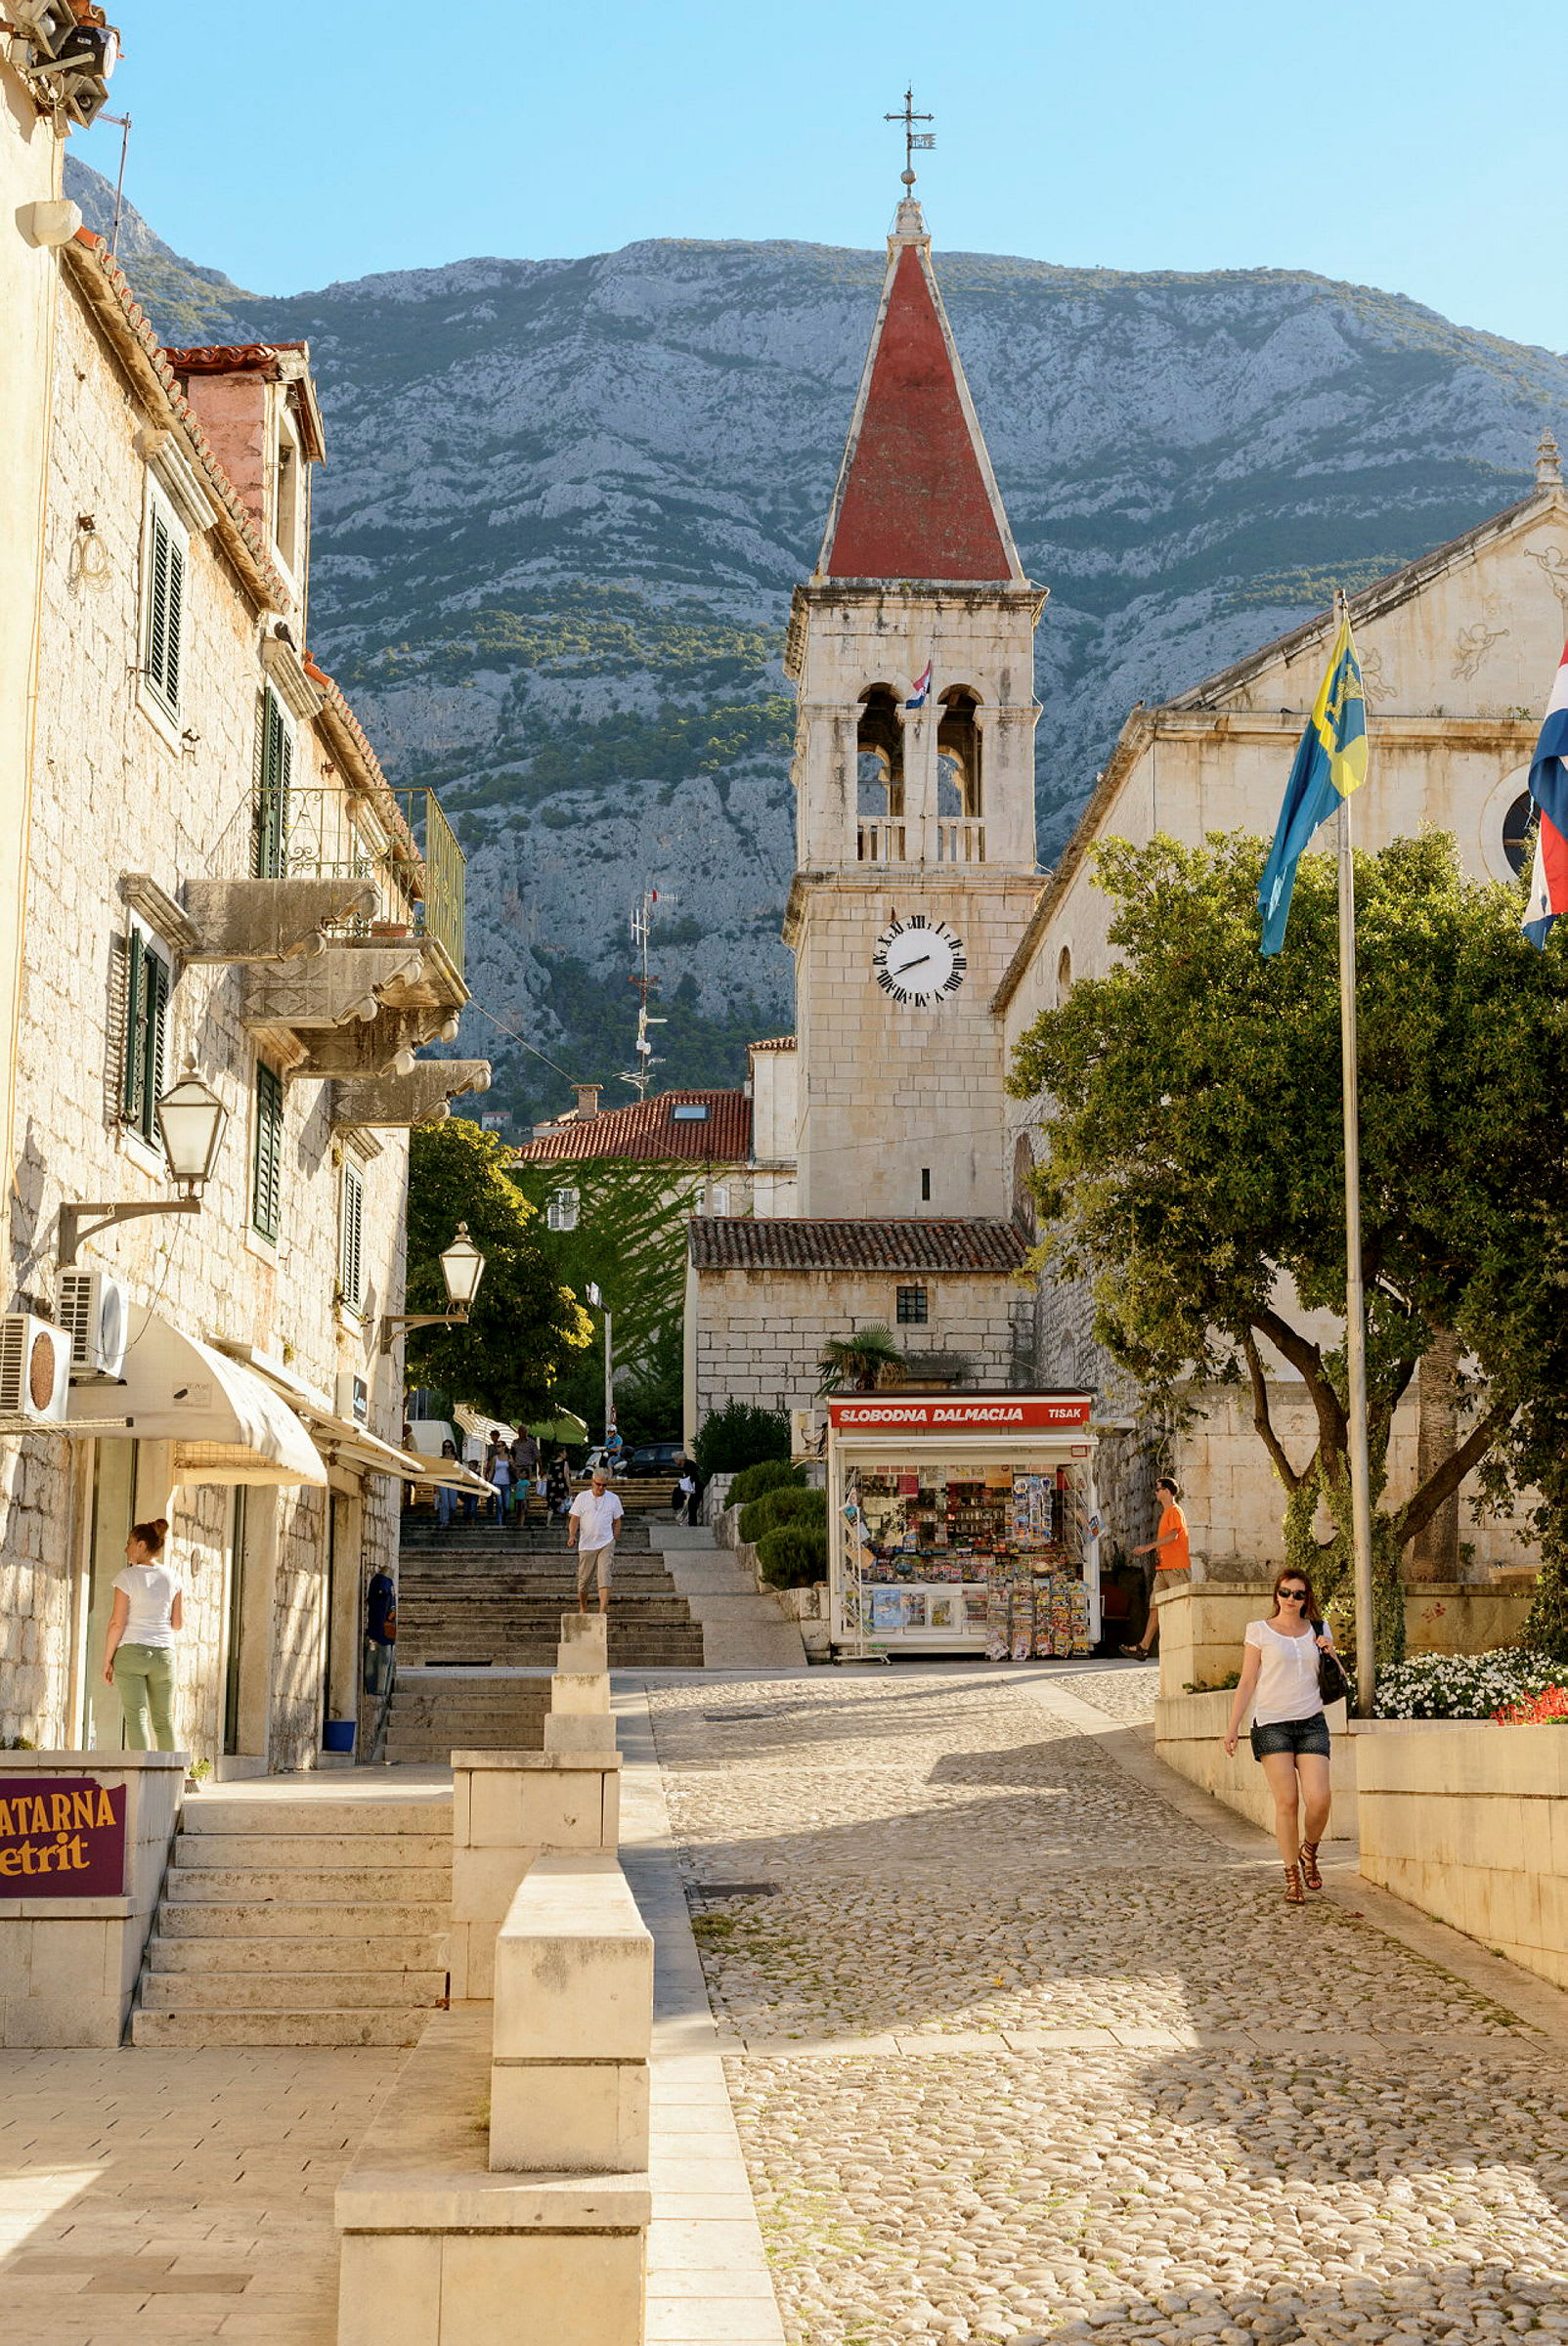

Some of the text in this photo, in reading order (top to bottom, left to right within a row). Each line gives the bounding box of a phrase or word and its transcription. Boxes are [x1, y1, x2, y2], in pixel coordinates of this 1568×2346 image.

[840, 1408, 1024, 1422] SLOBODNA DALMACIJA
[1048, 1409, 1081, 1418] TISAK
